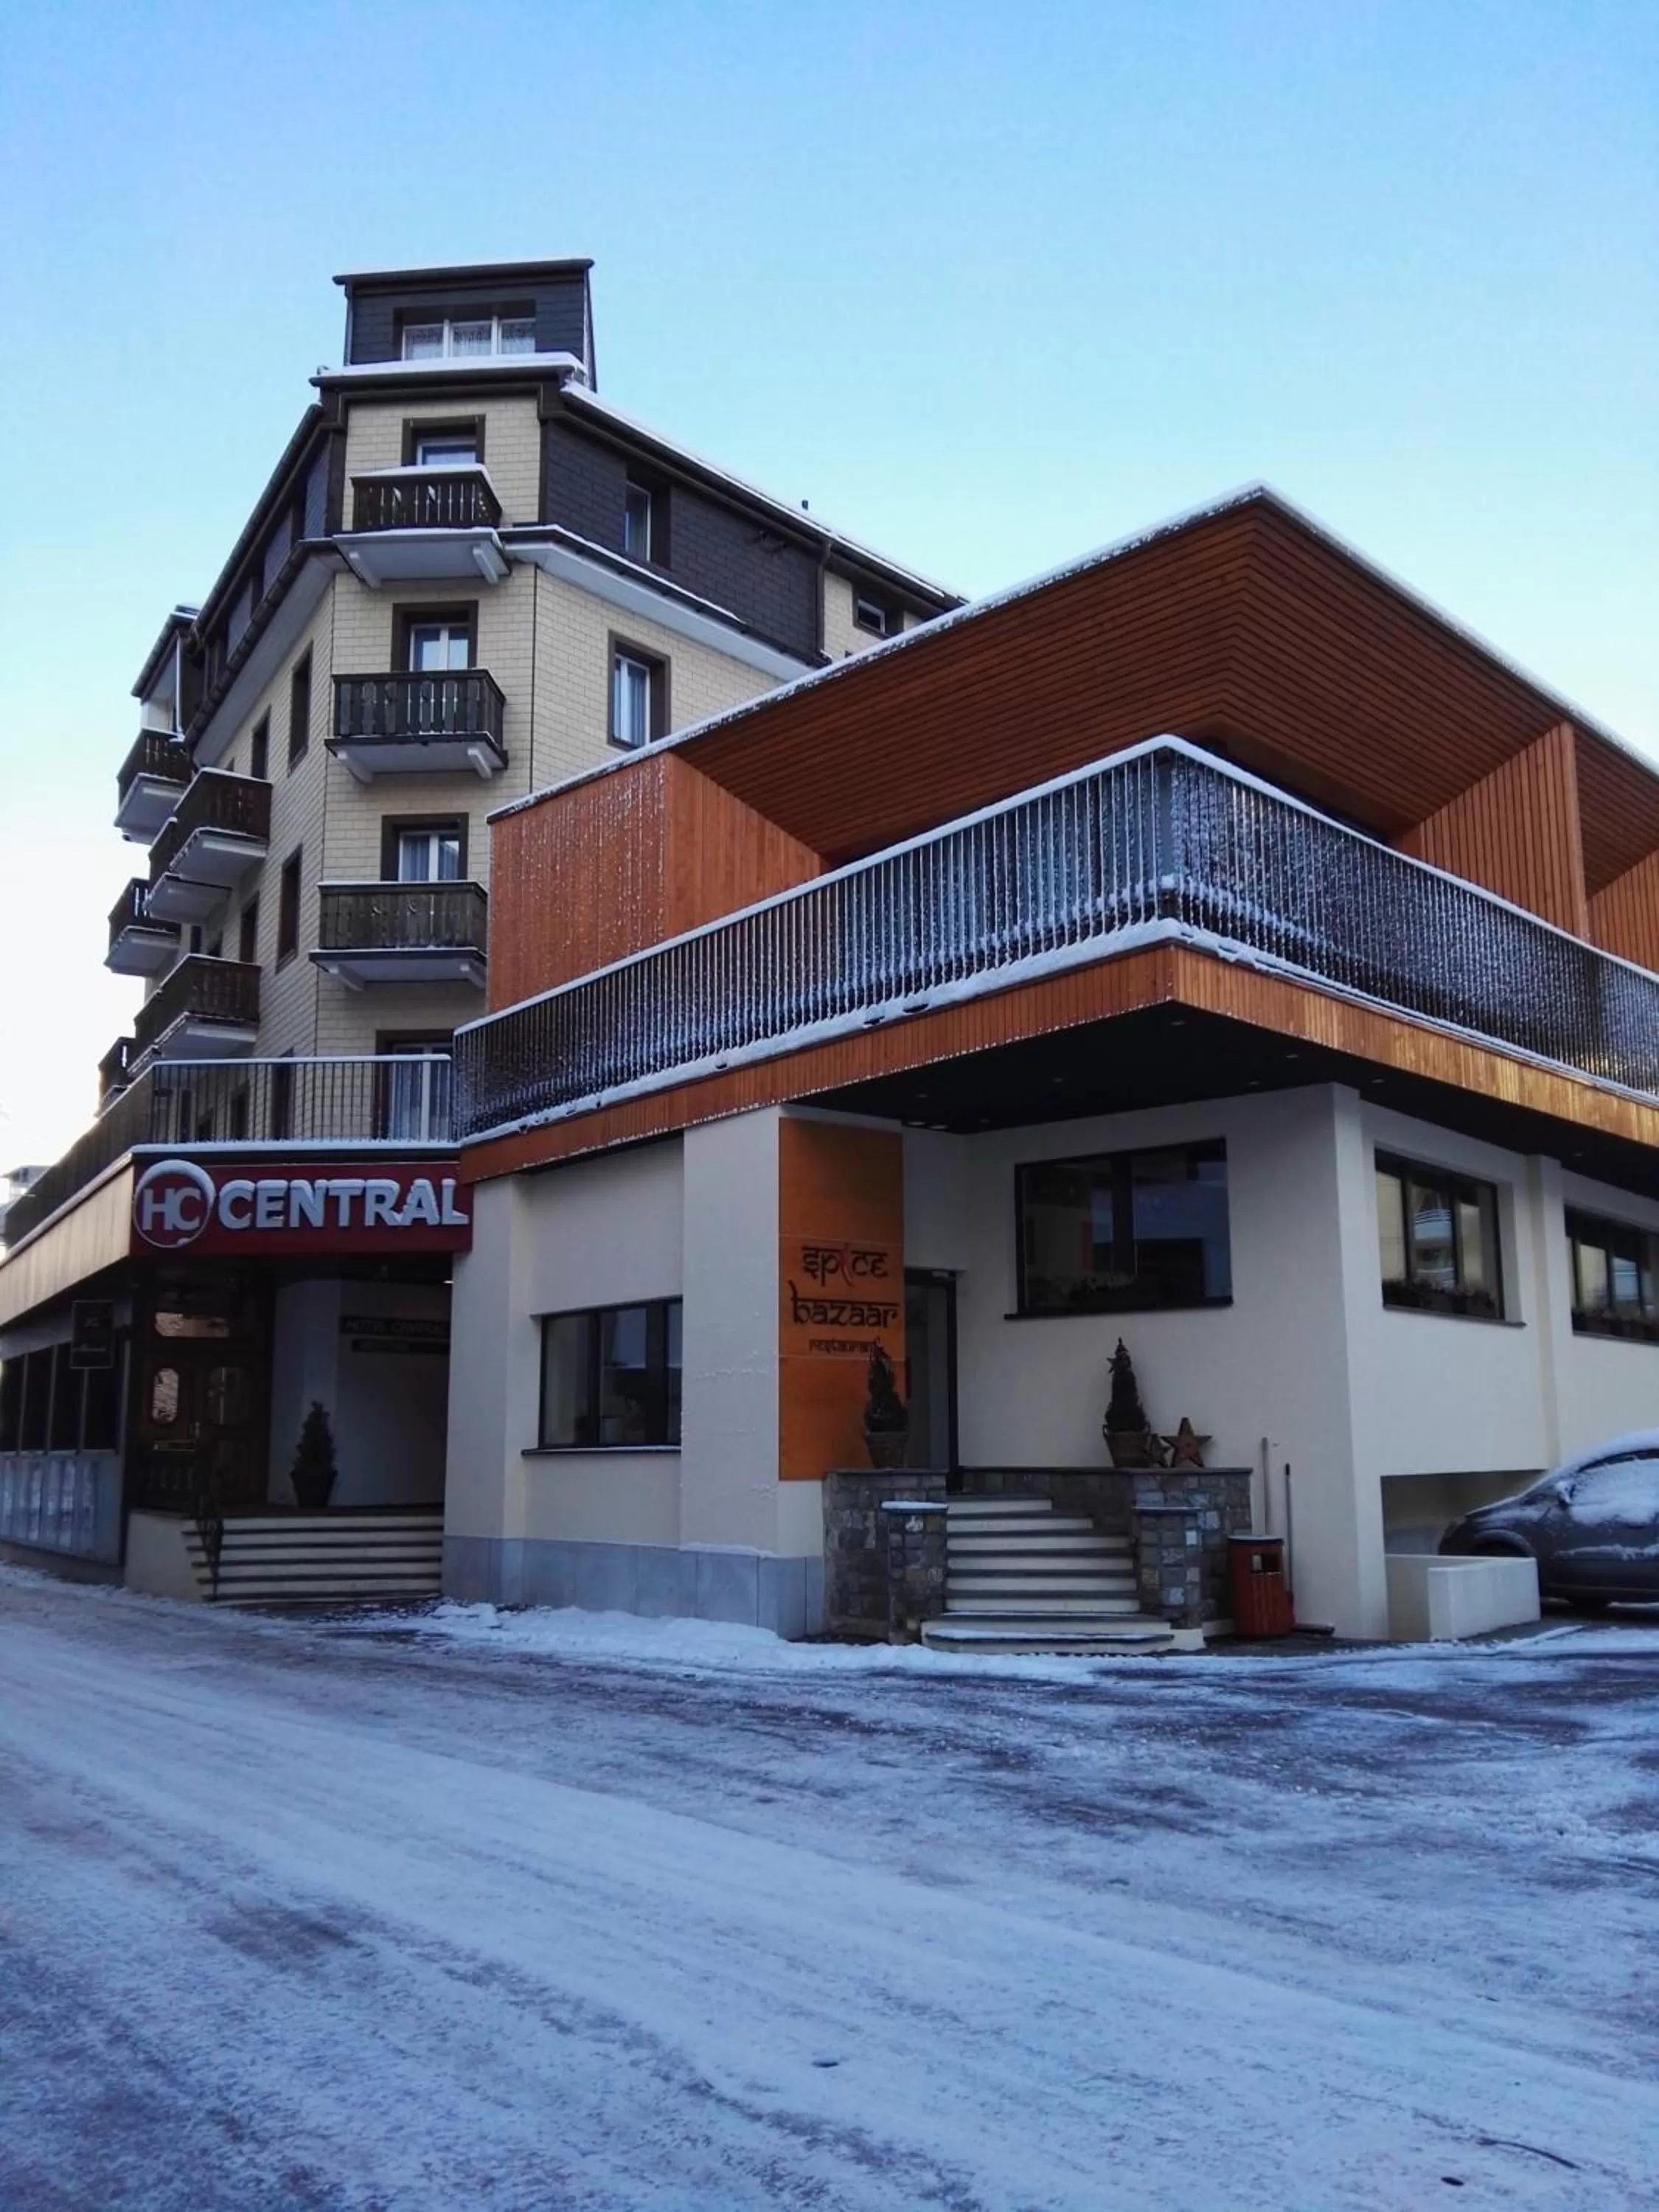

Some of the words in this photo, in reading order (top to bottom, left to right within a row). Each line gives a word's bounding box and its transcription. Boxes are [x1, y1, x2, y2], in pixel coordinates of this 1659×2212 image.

[142, 1187, 201, 1231] HC
[218, 1178, 470, 1229] CENTRAL
[787, 1280, 900, 1328] bazaar
